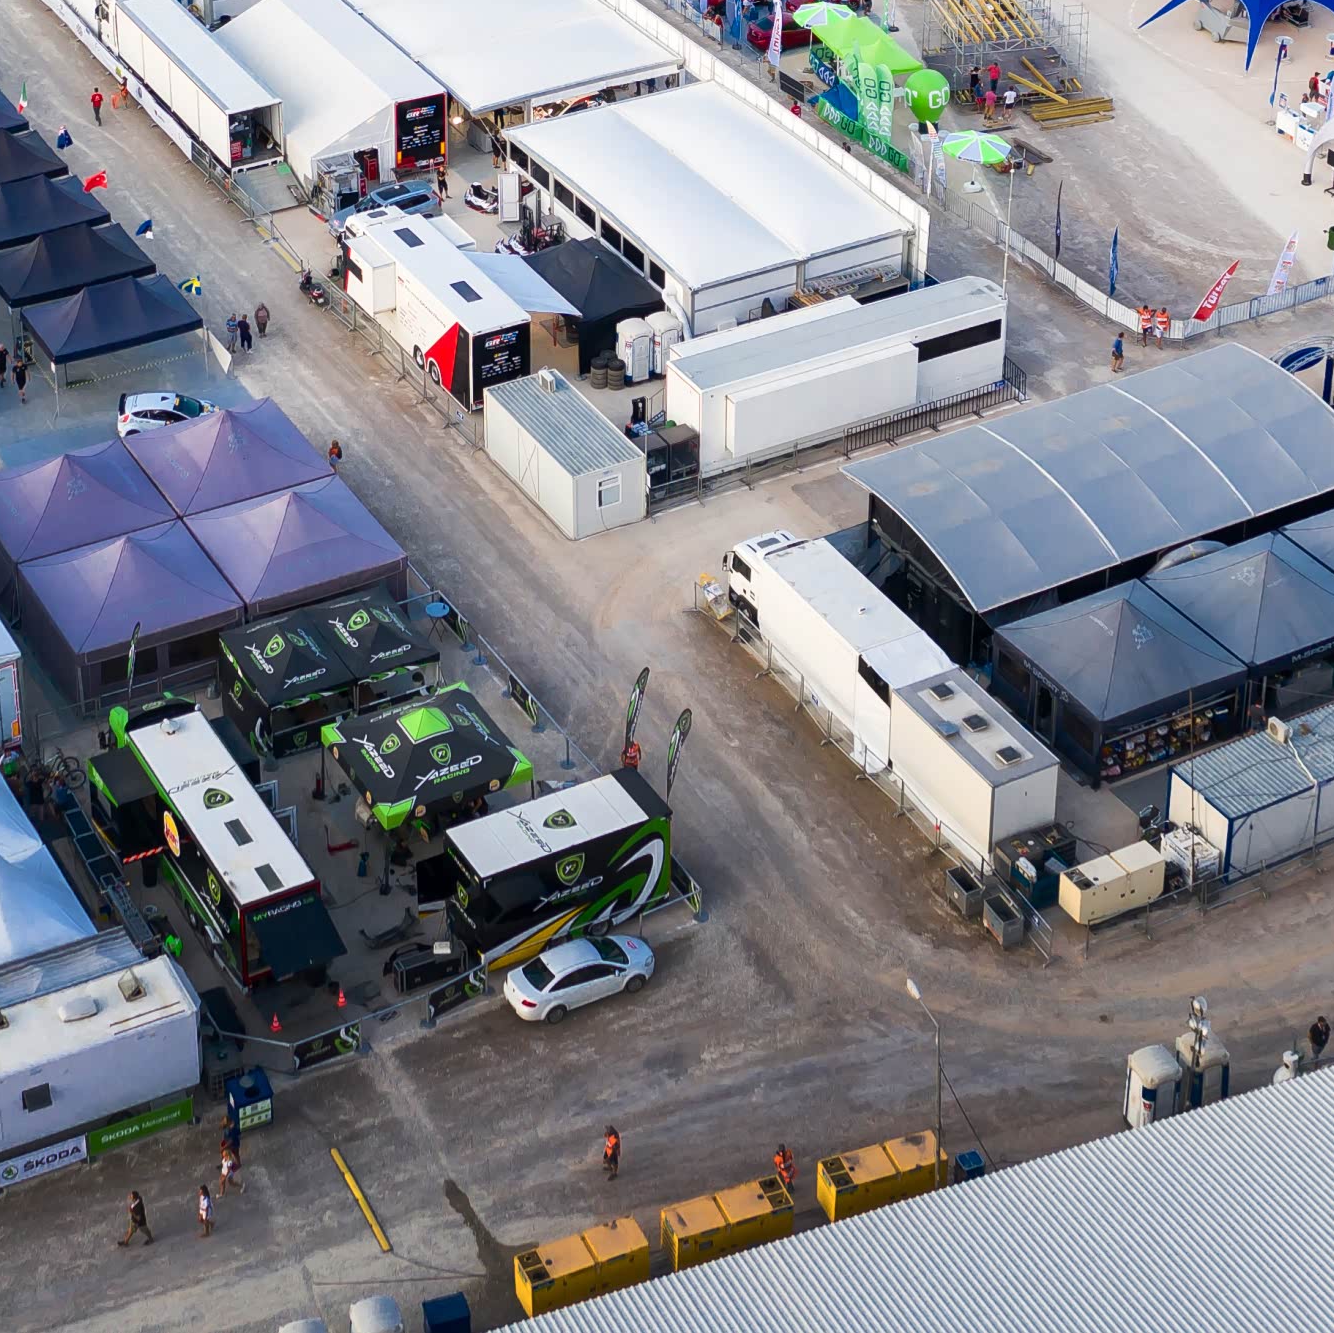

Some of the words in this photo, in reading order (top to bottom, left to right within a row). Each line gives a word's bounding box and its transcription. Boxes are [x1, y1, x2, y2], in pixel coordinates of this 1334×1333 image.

[929, 86, 951, 109] GO
[1023, 660, 1061, 692] M-SPORT
[352, 734, 396, 779] YAZEED
[414, 755, 483, 791] YAZEED
[433, 767, 470, 785] RACING
[533, 875, 604, 913] YAZEED
[100, 1124, 141, 1144] ŠKODA
[22, 1144, 83, 1173] ŠKODA
